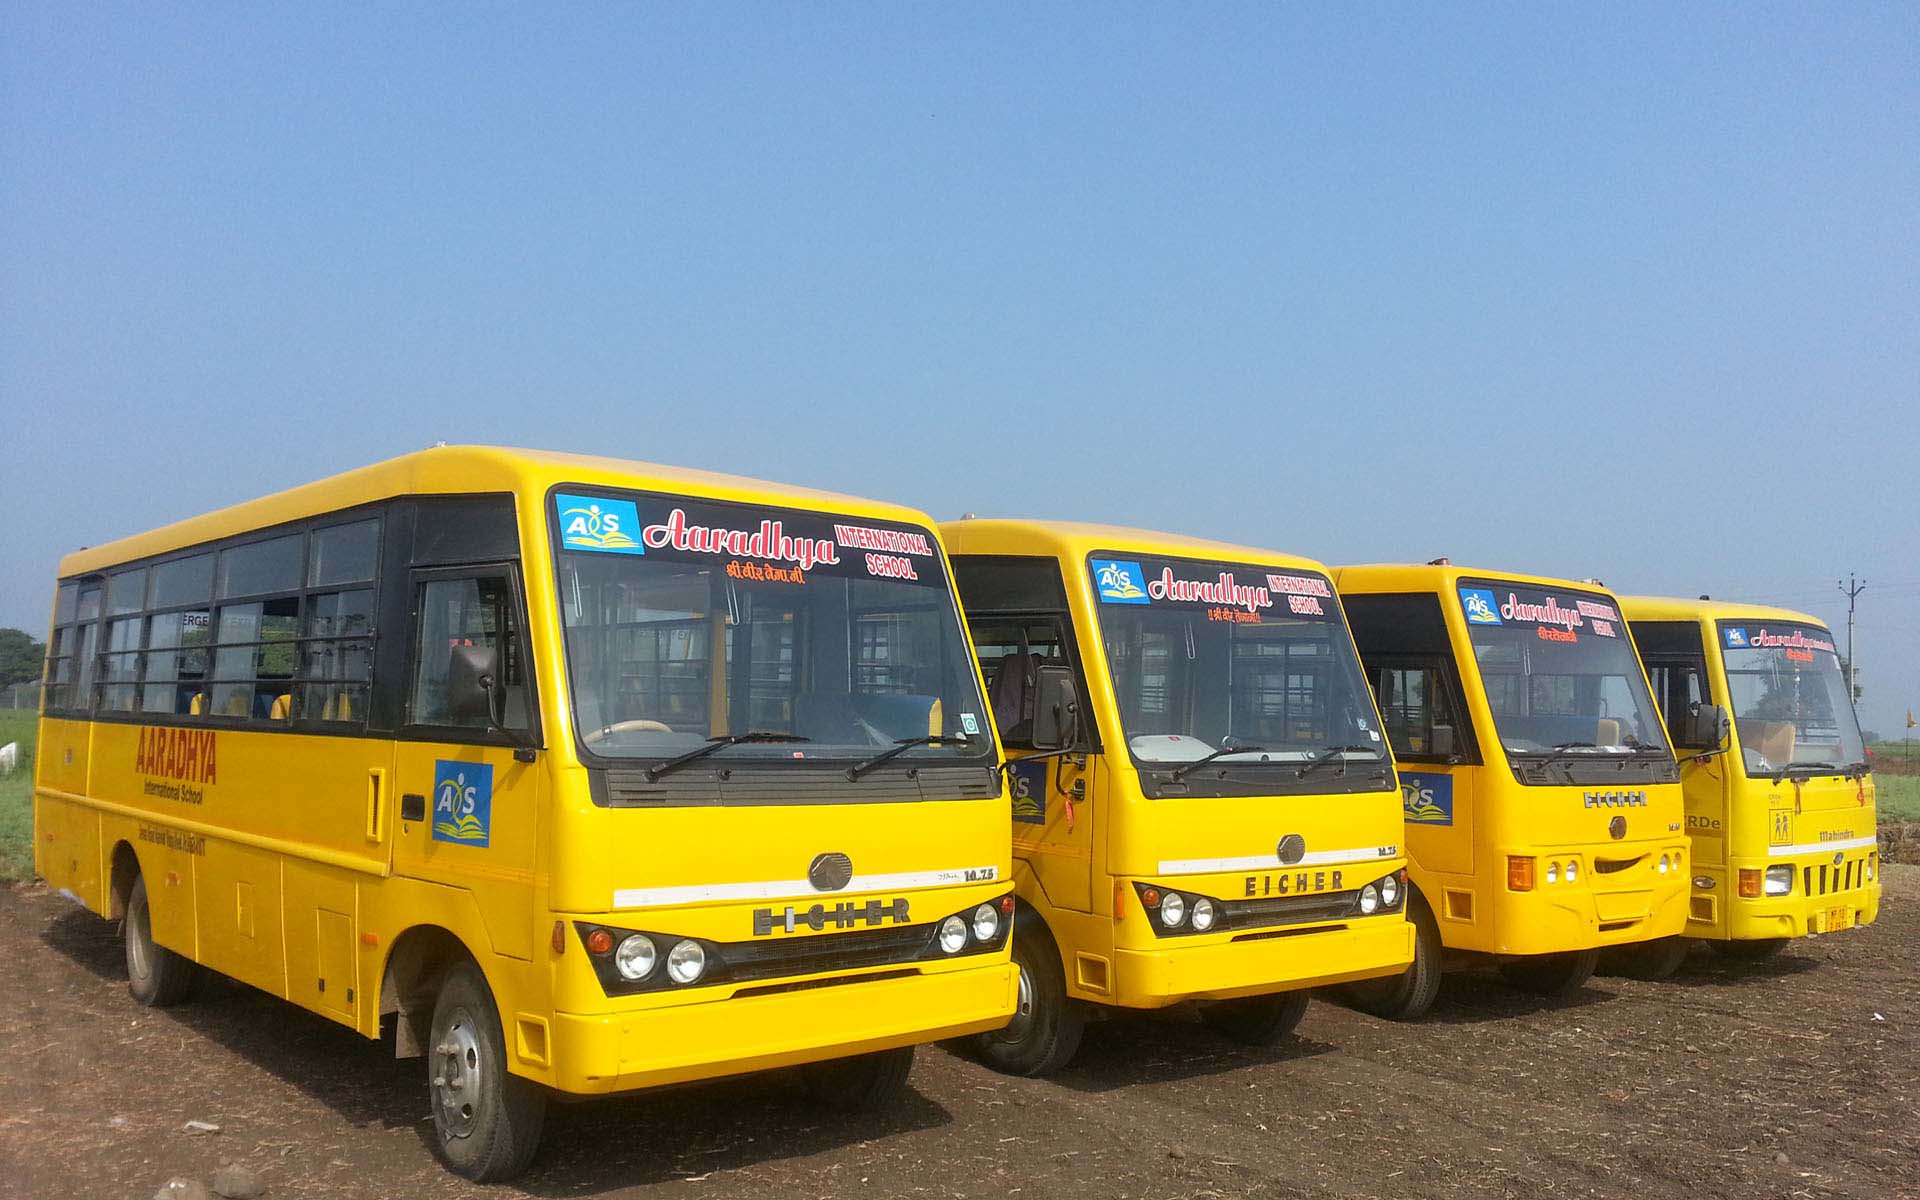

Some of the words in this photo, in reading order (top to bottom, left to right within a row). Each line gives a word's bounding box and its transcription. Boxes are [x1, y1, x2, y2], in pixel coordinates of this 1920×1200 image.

[642, 508, 840, 571] Aaradhya
[834, 523, 932, 557] INTERNATIONAL
[864, 552, 918, 581] SCHOOL
[1148, 567, 1273, 612] Aaradhya
[1265, 574, 1332, 598] INTERNATIONAL
[1287, 594, 1324, 616] SCHOOL
[1501, 593, 1584, 631] Aaradhya
[136, 726, 217, 785] AARADHYA
[144, 780, 180, 802] International
[180, 783, 204, 806] School
[1583, 791, 1648, 809] EICHER
[1685, 815, 1721, 830] RDe
[1819, 828, 1854, 843] Mahindra
[1245, 870, 1343, 898] EICHER
[752, 898, 911, 937] EICHER
